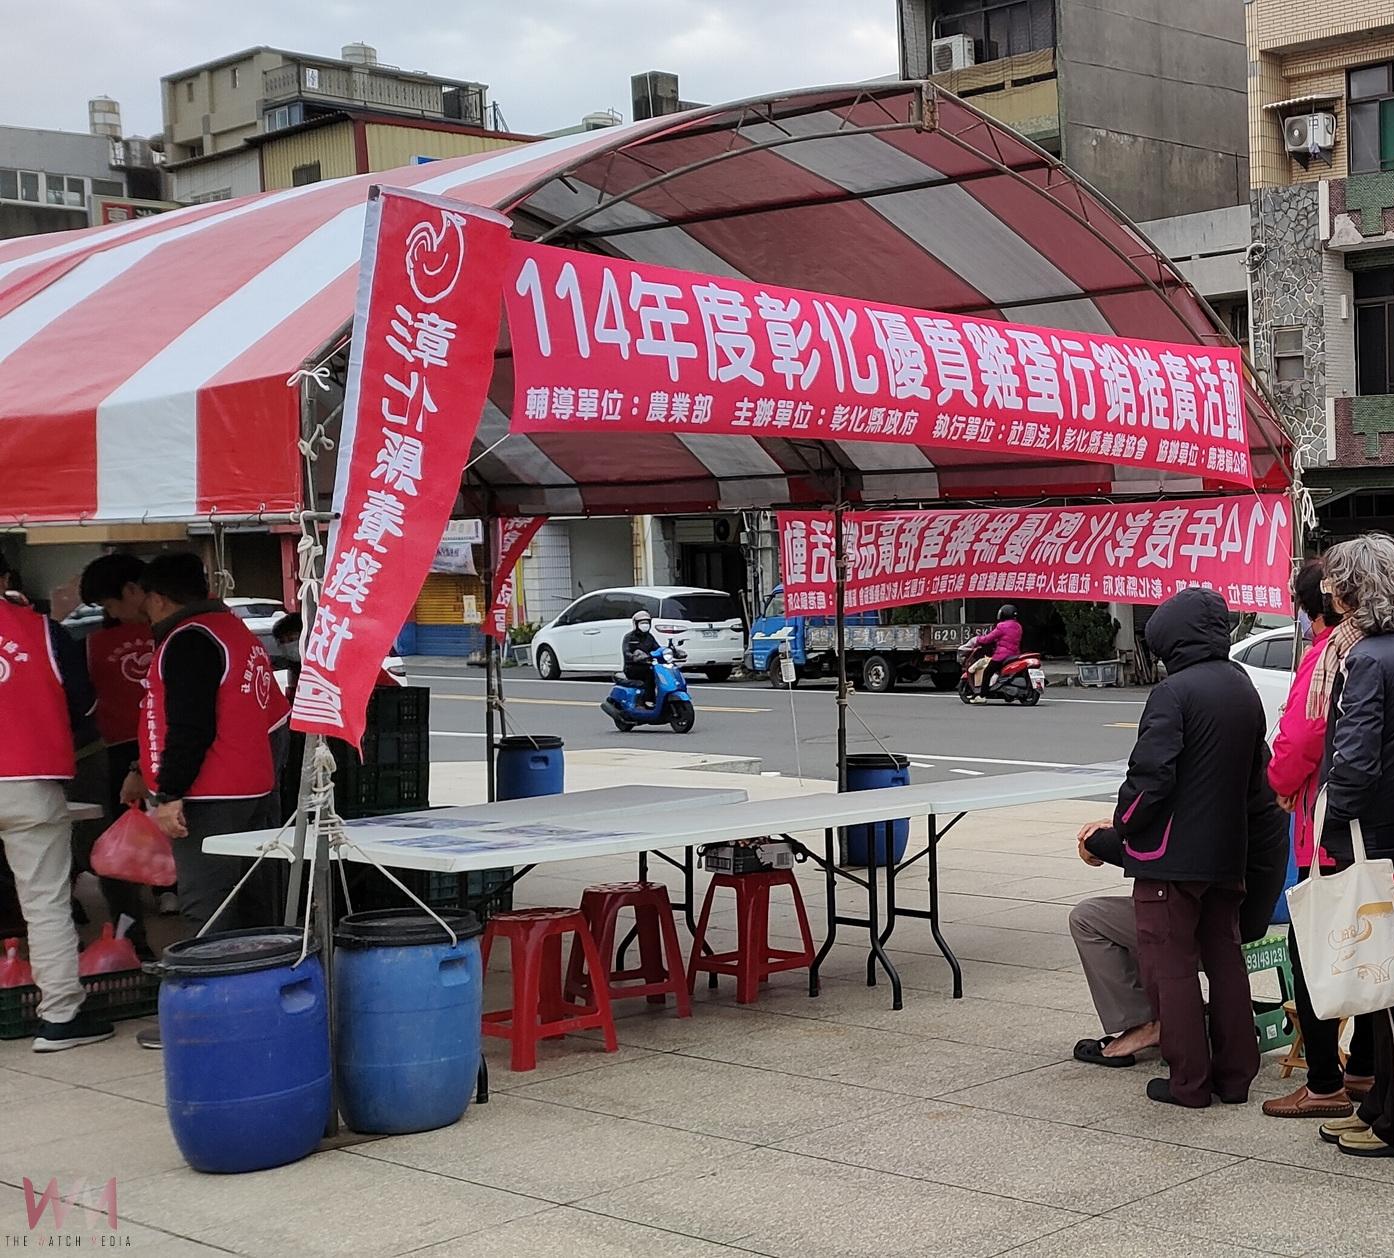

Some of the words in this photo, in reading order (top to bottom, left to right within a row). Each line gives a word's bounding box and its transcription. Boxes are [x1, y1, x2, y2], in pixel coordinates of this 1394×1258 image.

[515, 257, 1245, 444] 114年度彰化優質雞蛋行銷推廣活動
[525, 386, 714, 424] 輔導單位：農業部
